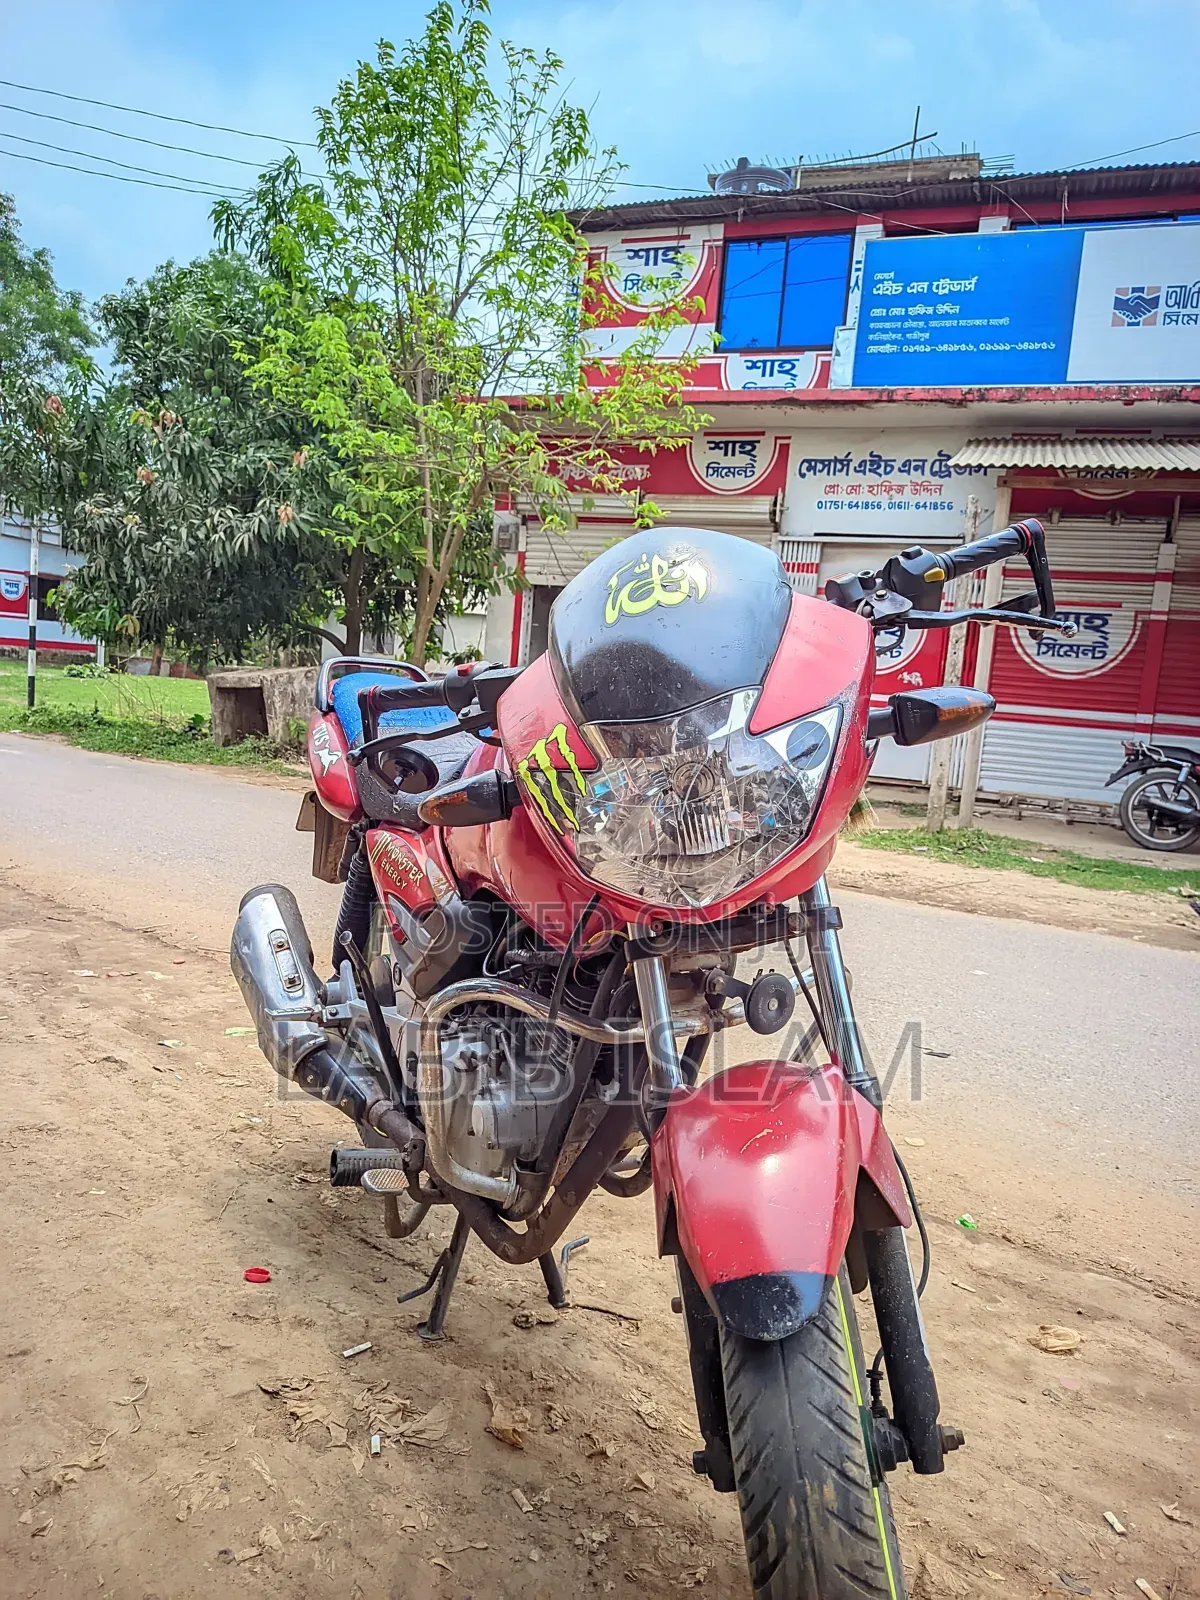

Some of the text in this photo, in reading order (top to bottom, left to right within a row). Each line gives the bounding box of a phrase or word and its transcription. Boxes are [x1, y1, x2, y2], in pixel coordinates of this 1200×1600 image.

[873, 276, 979, 296] এইচ এন ট্রেডার্স
[908, 304, 934, 316] হাফিজ
[936, 303, 960, 315] উদ্দিন
[705, 461, 756, 479] সিমেন্ট
[798, 452, 853, 479] মেসার্স
[854, 450, 896, 479] এইচ
[898, 458, 928, 477] এন
[866, 479, 908, 497] হাফিজ
[910, 479, 944, 497] উদ্দিন
[1036, 637, 1110, 660] সিমেন্ট
[312, 722, 330, 746] TVS
[380, 858, 408, 891] ENERGY
[386, 841, 424, 887] MONSTER
